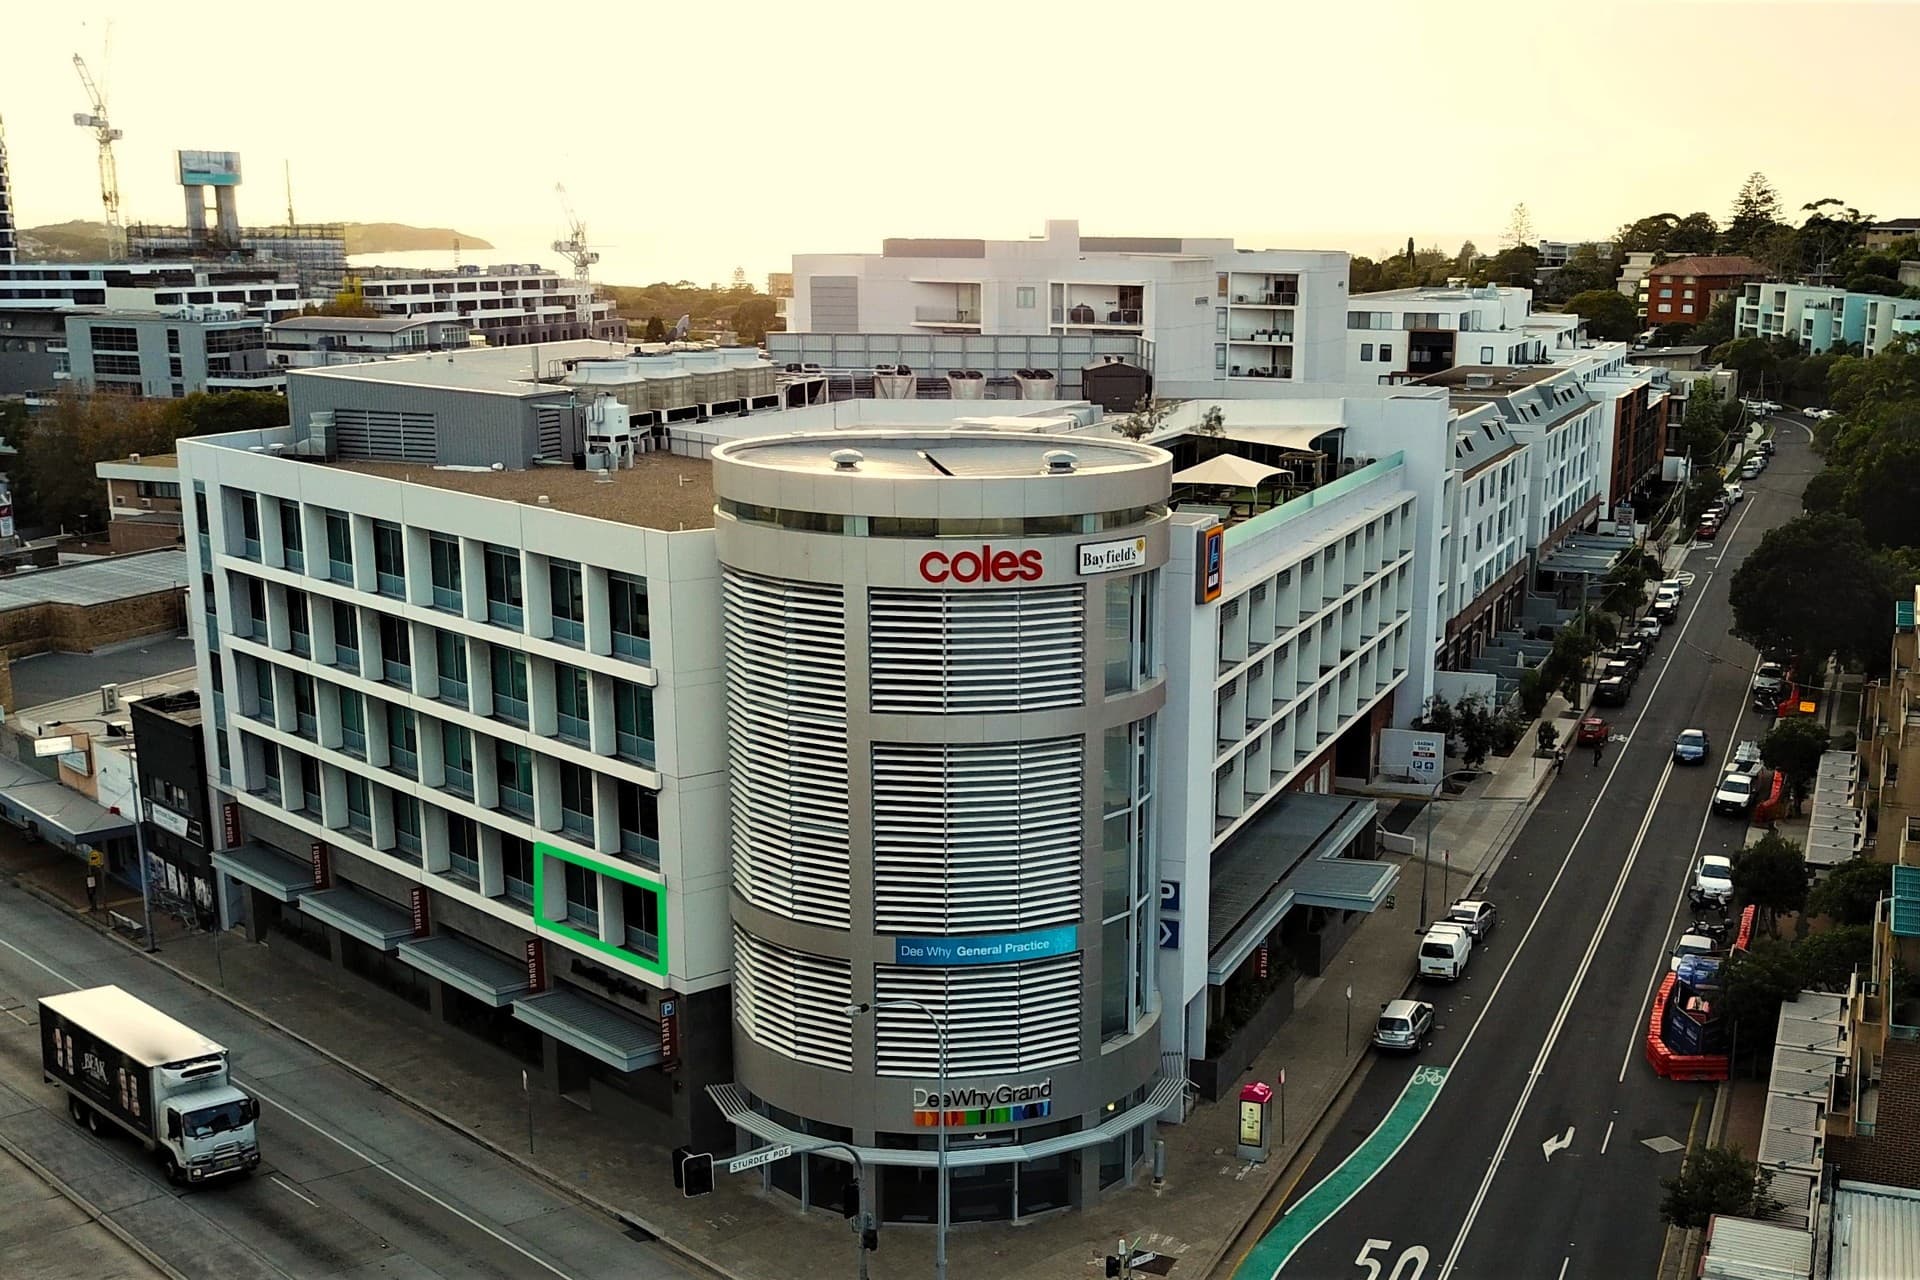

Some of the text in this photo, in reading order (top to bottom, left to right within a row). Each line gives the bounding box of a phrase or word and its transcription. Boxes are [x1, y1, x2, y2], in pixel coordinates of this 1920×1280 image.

[919, 545, 1044, 583] coles
[1083, 546, 1137, 567] Bayfield's
[901, 938, 1050, 959] Dee Why General Practice
[527, 942, 538, 988] VIP LOUNGE
[661, 1017, 671, 1043] LEVEL
[732, 1147, 790, 1170] STURDEE PDE
[1354, 1238, 1430, 1280] 50
